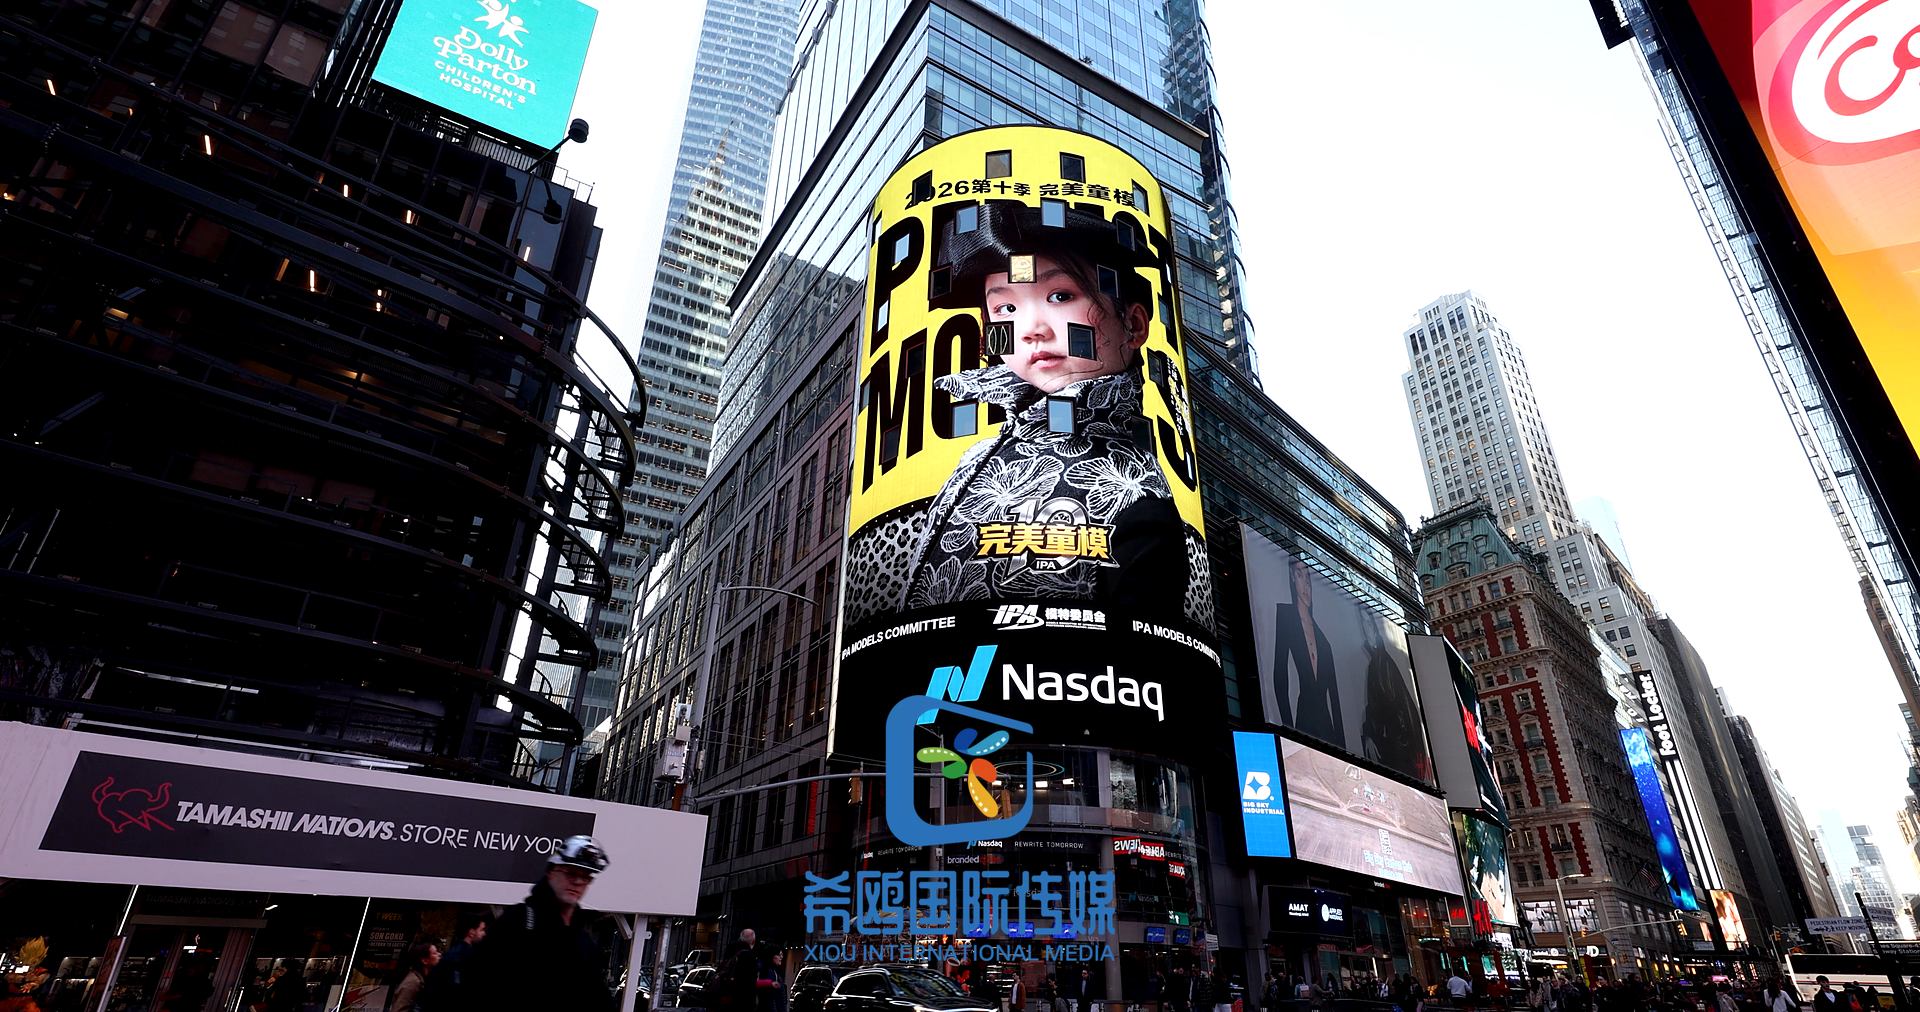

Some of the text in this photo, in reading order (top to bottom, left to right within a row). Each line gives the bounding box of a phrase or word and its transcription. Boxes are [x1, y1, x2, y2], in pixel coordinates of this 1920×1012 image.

[433, 36, 537, 95] Parton
[454, 26, 529, 71] Dolly
[434, 60, 527, 104] CHILDREN'S
[439, 73, 516, 110] HOSPITAL
[1039, 182, 1139, 211] 完美童模
[977, 523, 1110, 560] 完美童模
[1036, 560, 1057, 570] IPA
[992, 604, 1040, 625] IPA
[851, 631, 884, 654] MODELS
[884, 615, 957, 640] COMMITTEE
[1132, 620, 1152, 635] IPA
[1153, 624, 1193, 647] MODELS
[1001, 663, 1165, 723] Nasdaq
[1639, 673, 1677, 756] Foot Locker
[176, 801, 564, 855] TAMASHII NATIONS STORE NEW YOR
[1243, 807, 1285, 816] INDUSTRIAL
[947, 855, 980, 865] branded
[978, 840, 1003, 849] Nasdaq
[1288, 903, 1309, 912] AMAT
